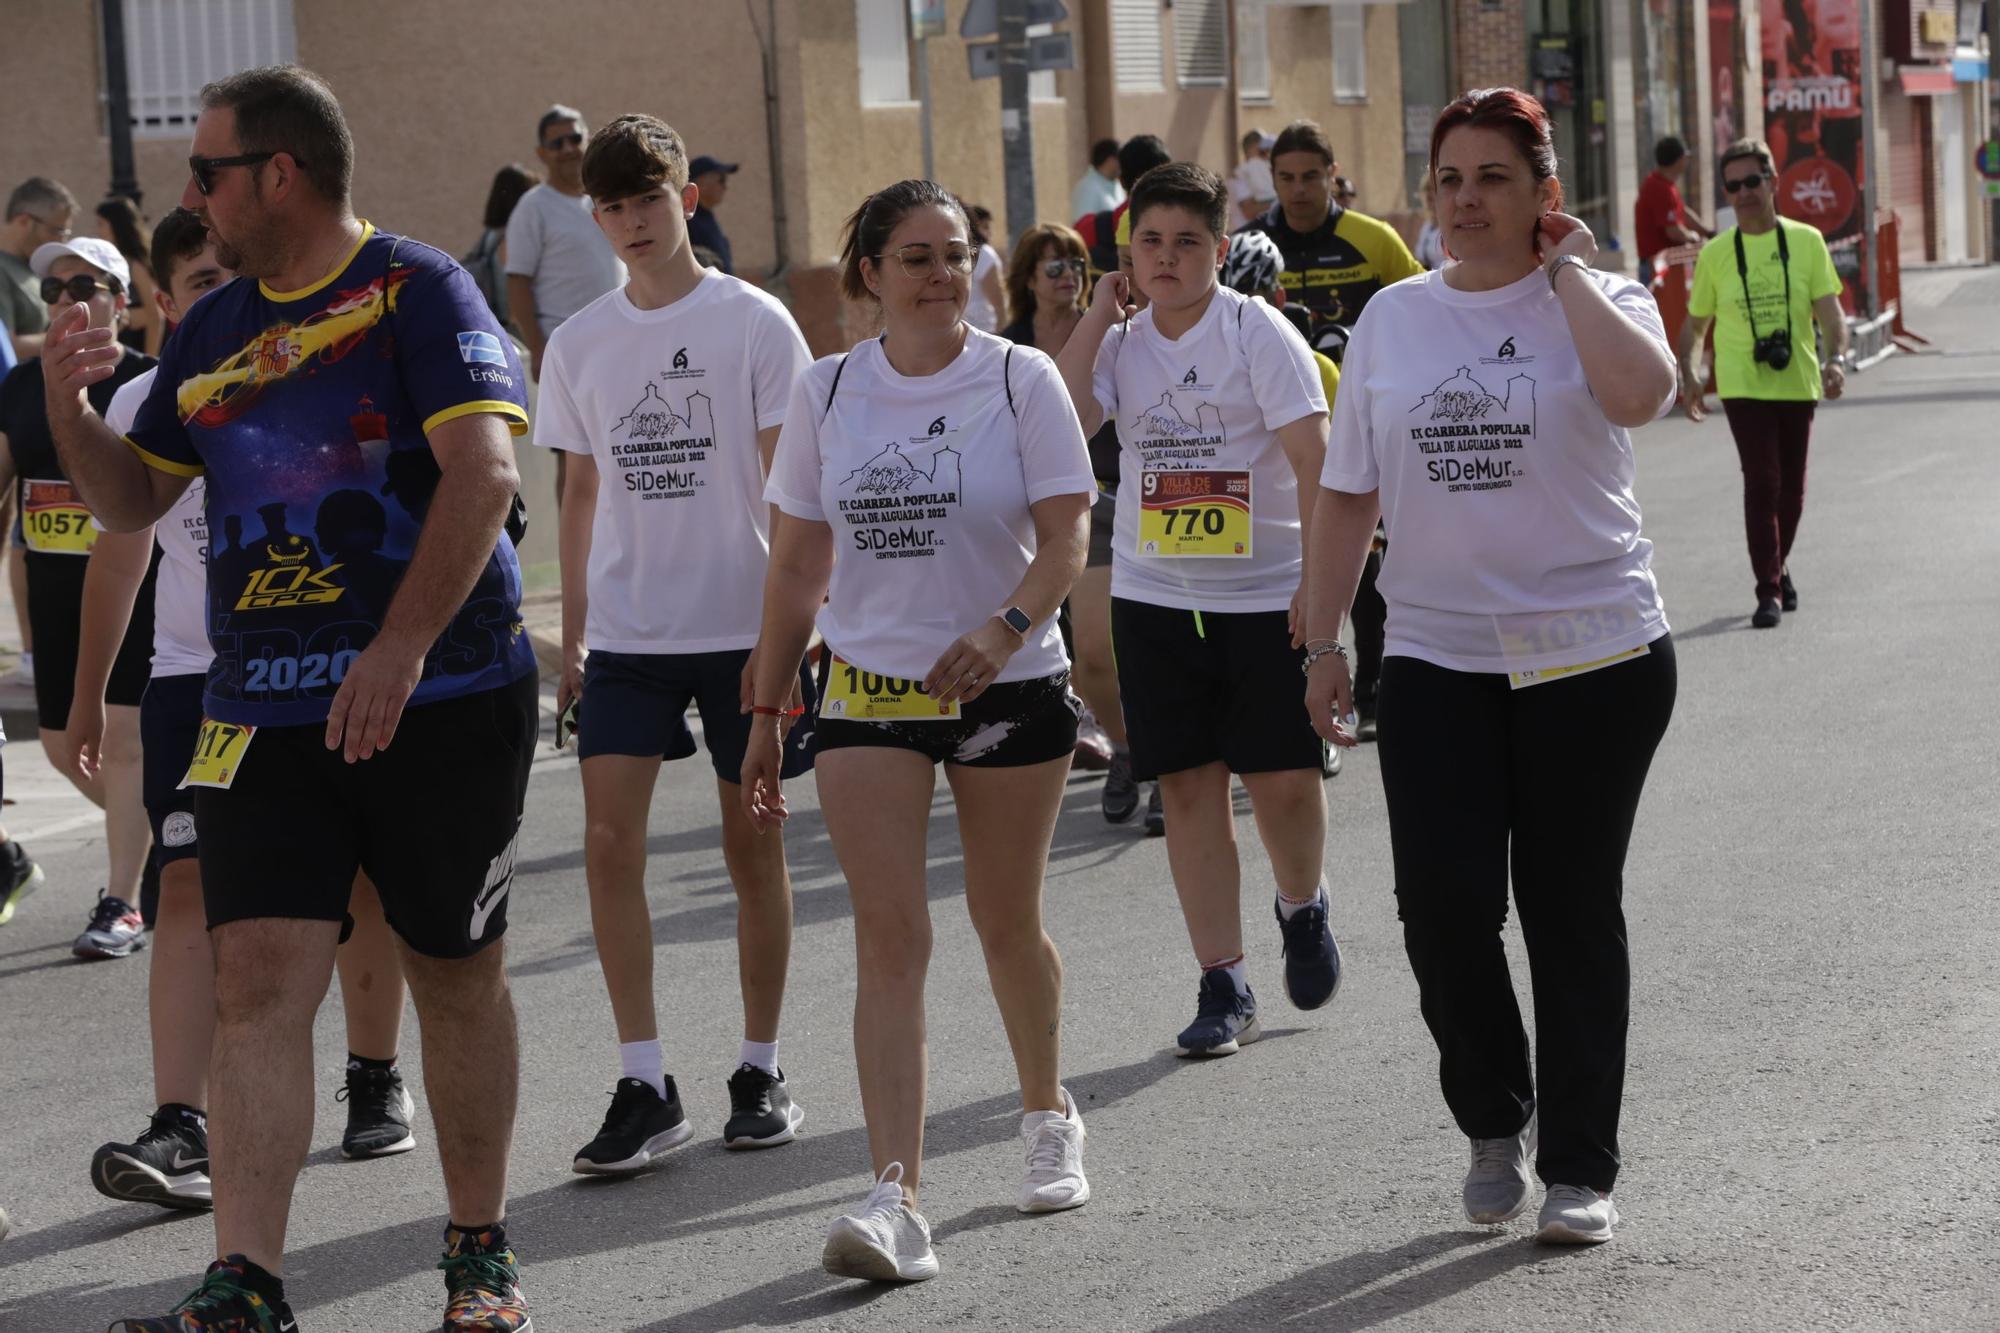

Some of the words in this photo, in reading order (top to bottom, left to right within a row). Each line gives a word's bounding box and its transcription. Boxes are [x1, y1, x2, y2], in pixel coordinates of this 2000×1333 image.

[469, 368, 513, 389] Ership
[1410, 428, 1424, 440] IX
[1424, 425, 1478, 438] CARRERA
[1480, 424, 1531, 436] POPULAR
[612, 445, 622, 455] IX
[624, 441, 668, 454] CARRERA
[670, 437, 712, 450] POPULAR
[1142, 438, 1182, 449] CARRERA
[1418, 442, 1442, 454] VILLA
[1444, 440, 1456, 452] DE
[1457, 438, 1500, 452] ALGUAZAS
[1504, 438, 1523, 449] 2022
[616, 456, 639, 468] VILLA
[640, 455, 650, 466] DE
[652, 453, 686, 466] ALGUAZAS
[688, 452, 706, 462] 2022
[1164, 448, 1199, 458] ALGUAZAS
[1427, 456, 1512, 482] SiDeMur
[624, 468, 696, 491] SiDeMur
[1162, 477, 1192, 486] VILLA
[1197, 477, 1211, 486] DE
[1448, 482, 1472, 492] CENTRO
[642, 492, 663, 500] CENTRO
[1162, 486, 1211, 495] ALGUAZAS
[1226, 484, 1248, 492] 2022
[839, 500, 848, 510] IX
[850, 497, 900, 510] CARRERA
[904, 492, 956, 506] POPULAR
[28, 512, 90, 535] 1057
[184, 518, 194, 528] IX
[845, 513, 868, 526] VILLA
[868, 512, 878, 524] DE
[881, 510, 924, 522] ALGUAZAS
[927, 508, 946, 519] 2022
[1162, 508, 1224, 536] 770
[854, 525, 934, 550] SiDeMur
[876, 551, 898, 560] CENTRO
[244, 650, 361, 692] 2020
